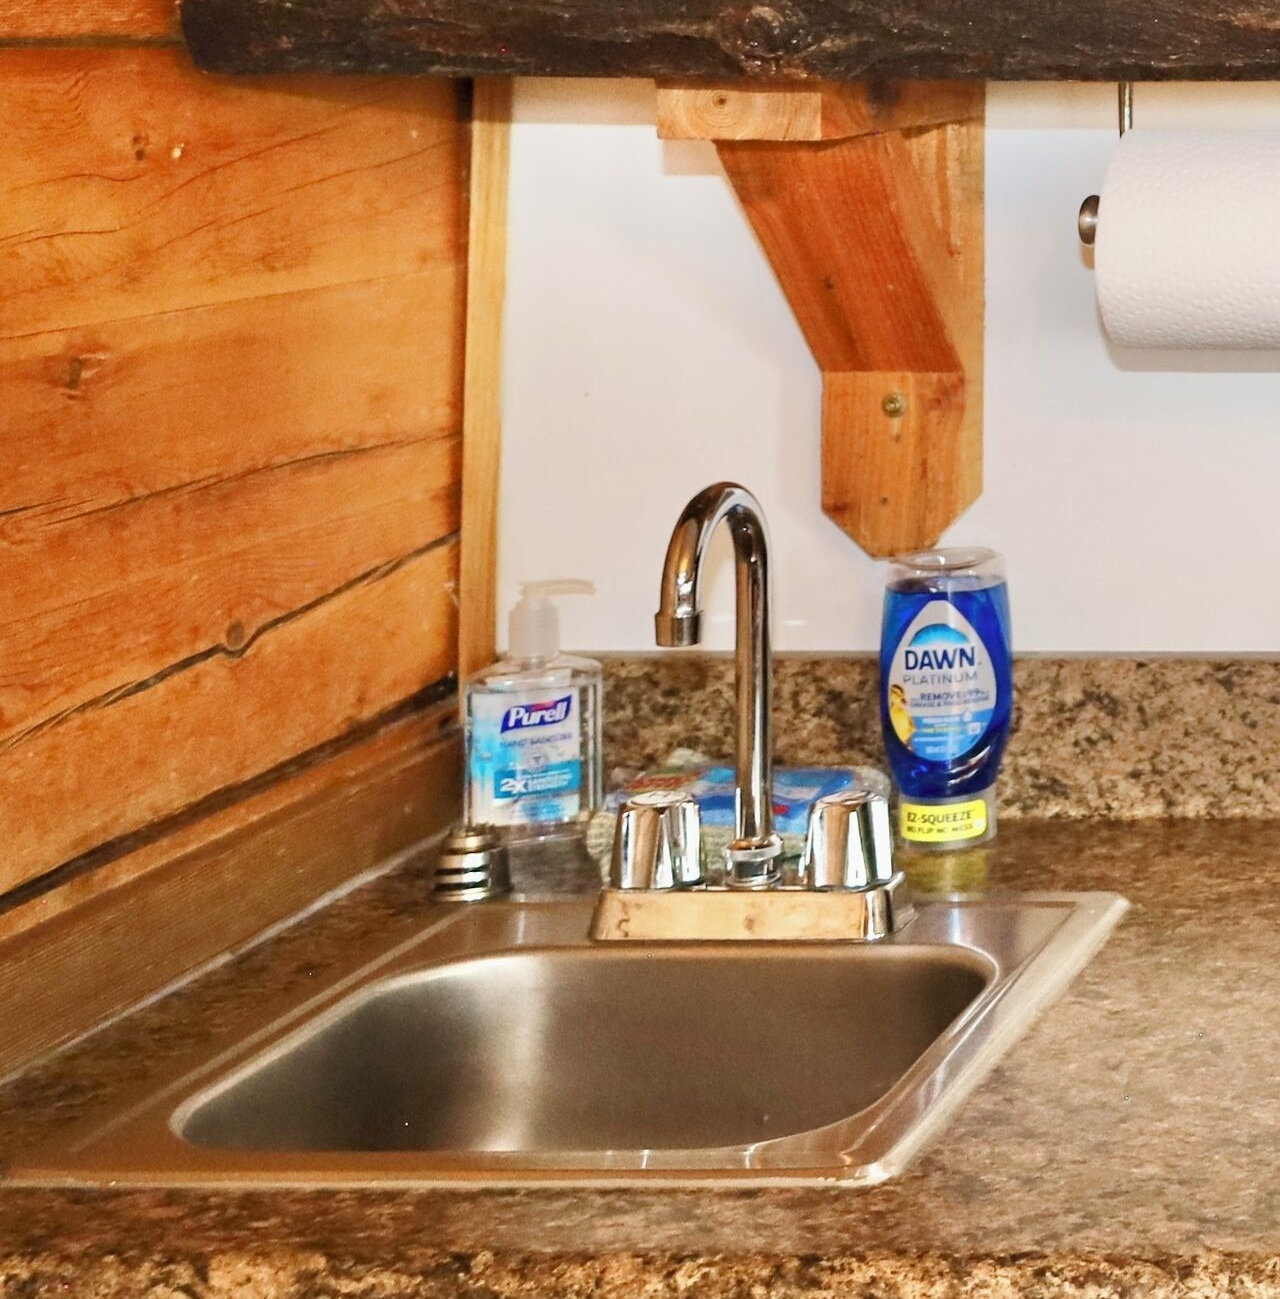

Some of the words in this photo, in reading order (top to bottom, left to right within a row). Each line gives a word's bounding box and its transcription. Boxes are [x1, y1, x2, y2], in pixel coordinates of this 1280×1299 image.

[904, 646, 975, 670] DAWN
[903, 671, 978, 685] PLATINUM
[507, 700, 568, 728] Purell
[906, 810, 972, 825] EZ-SQUEEZE
